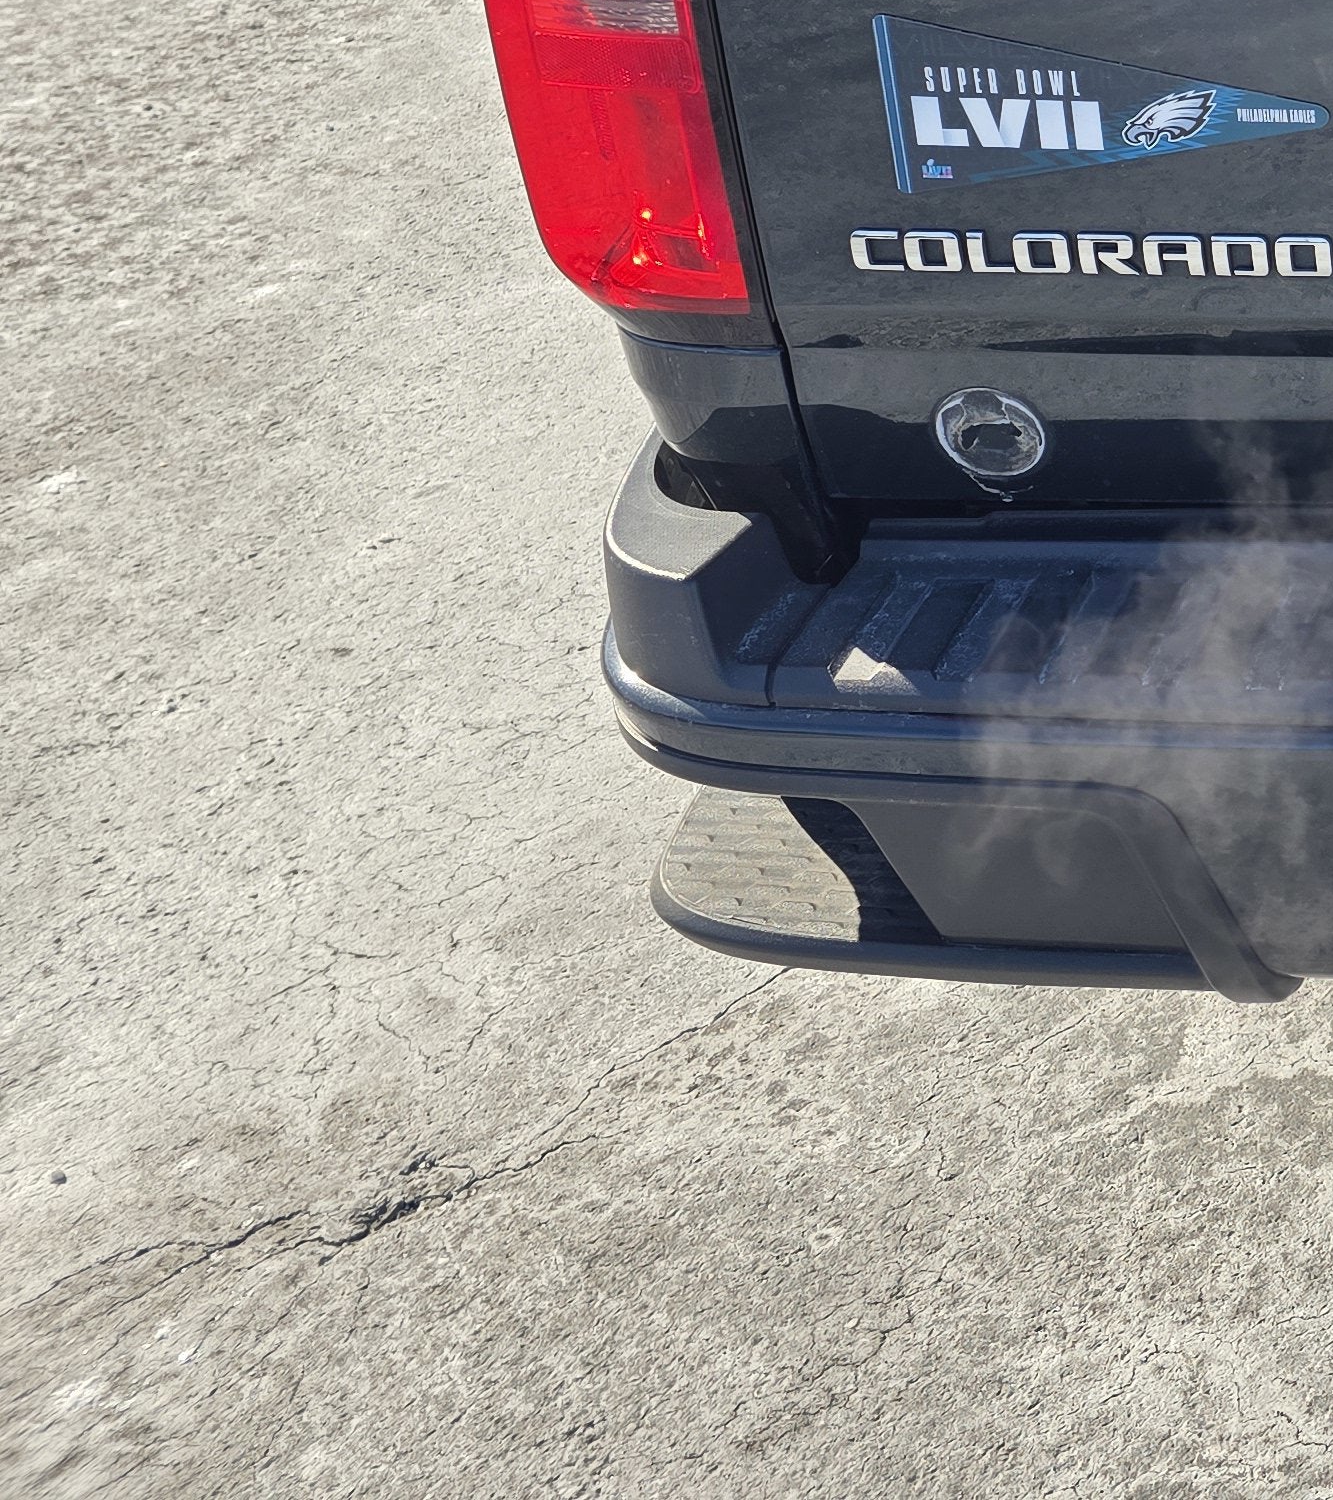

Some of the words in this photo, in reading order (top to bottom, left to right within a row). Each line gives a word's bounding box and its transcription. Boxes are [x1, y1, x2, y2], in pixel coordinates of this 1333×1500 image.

[924, 66, 1000, 94] SUPER
[1017, 69, 1081, 97] BOWL
[910, 95, 1105, 151] LVII
[1236, 108, 1288, 123] PHILADELPHIA
[1289, 109, 1316, 124] EAGLES
[850, 228, 1333, 277] COLORADO
